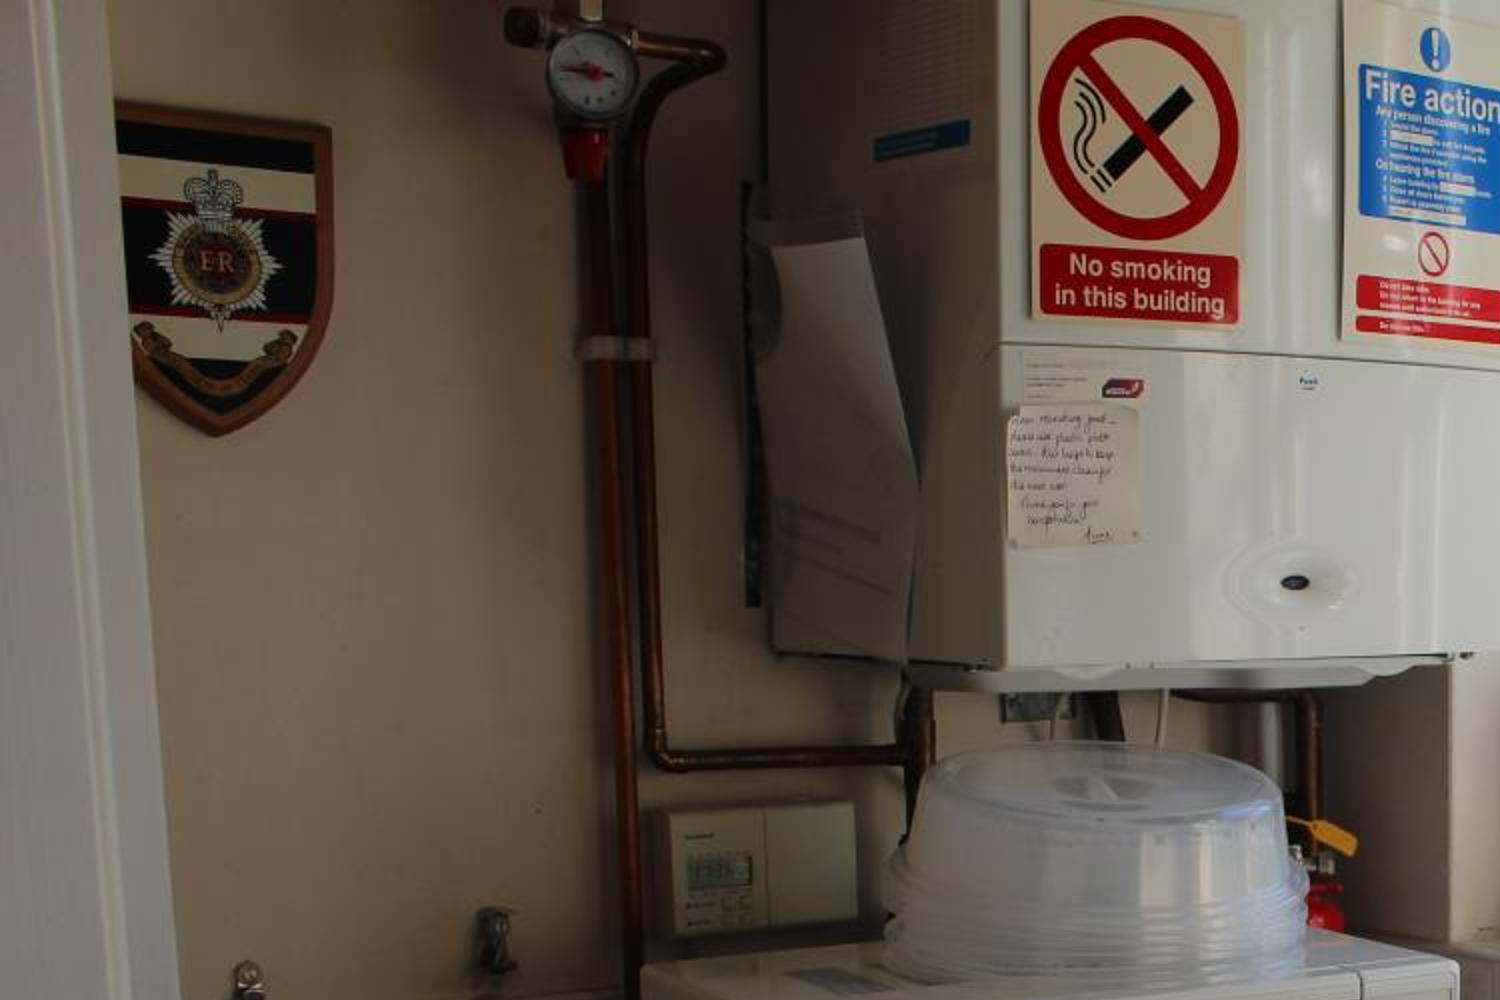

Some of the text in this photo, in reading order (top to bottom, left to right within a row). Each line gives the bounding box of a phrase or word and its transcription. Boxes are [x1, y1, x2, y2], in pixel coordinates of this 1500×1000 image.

[1365, 68, 1417, 107] Fire
[1069, 253, 1211, 288] No smoking
[1055, 284, 1225, 320] in this building
